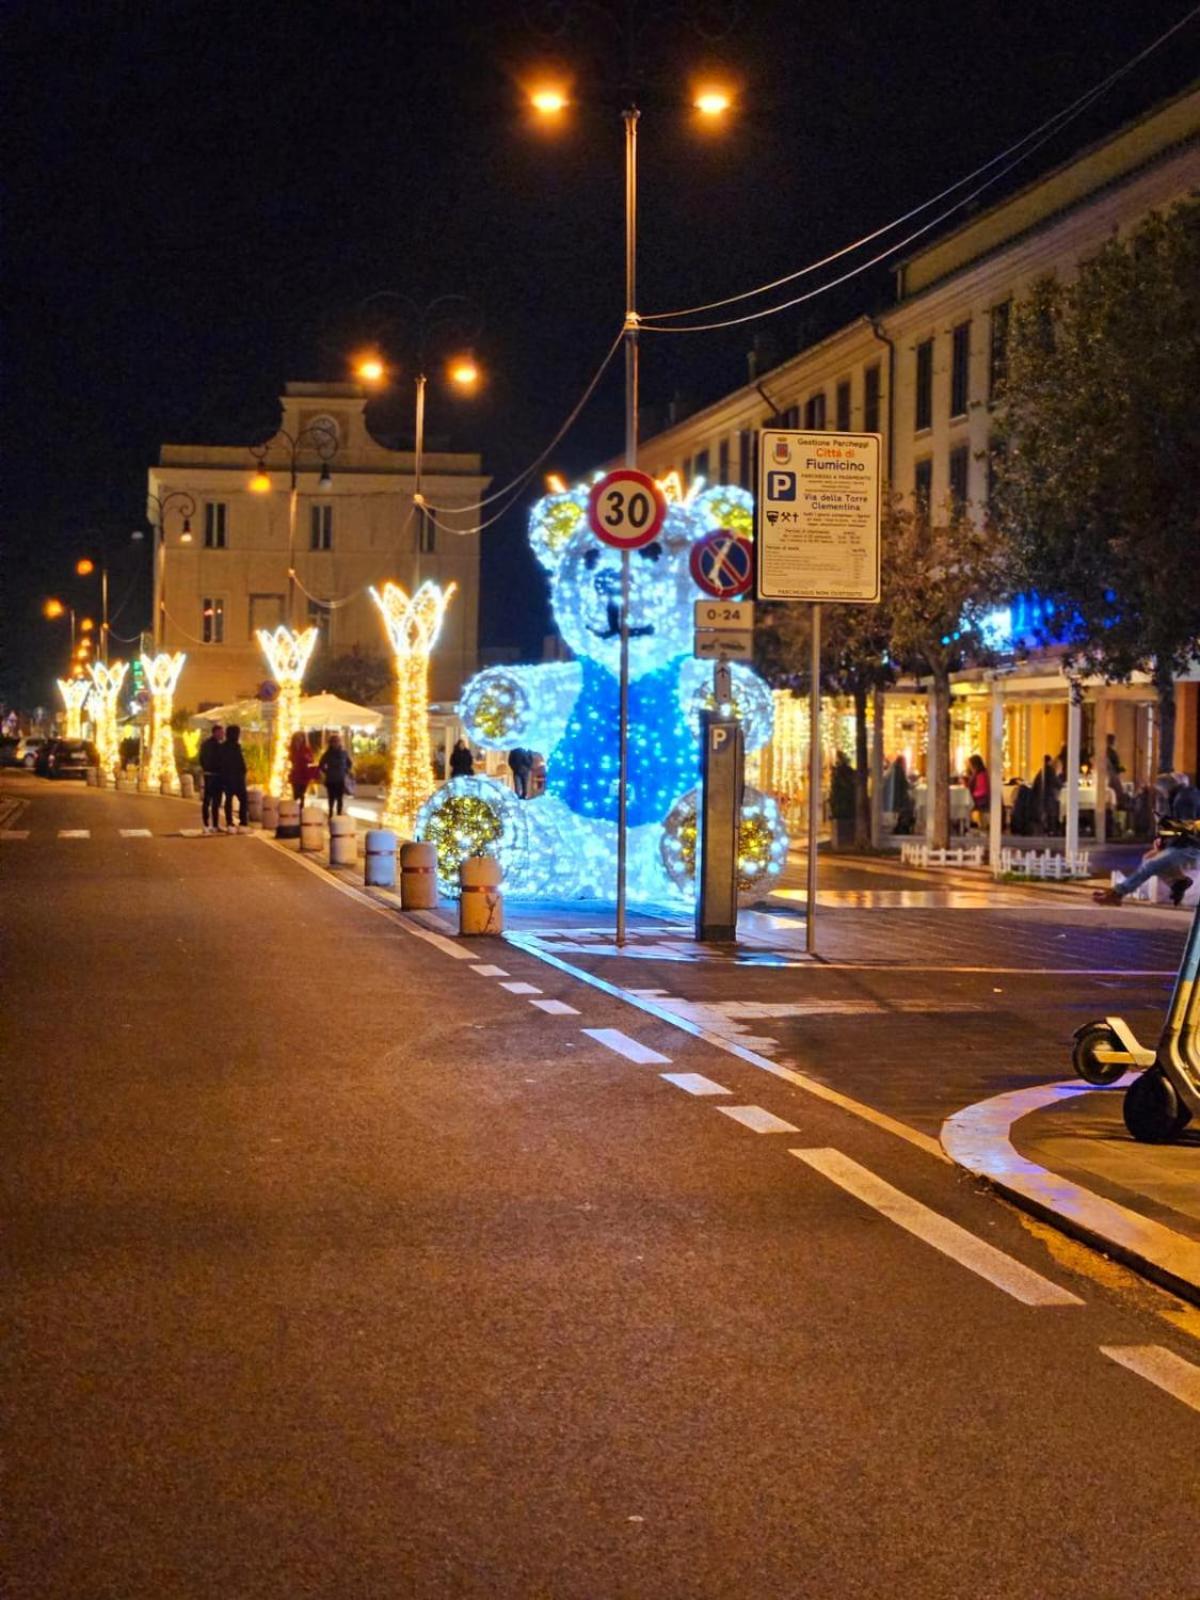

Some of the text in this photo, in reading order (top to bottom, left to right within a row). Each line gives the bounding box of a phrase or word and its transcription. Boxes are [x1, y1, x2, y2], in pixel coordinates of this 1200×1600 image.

[797, 438, 830, 446] Gestione
[816, 447, 855, 458] Città di
[806, 458, 865, 471] Fiumicino
[773, 474, 791, 498] P
[820, 494, 842, 502] della
[845, 494, 868, 503] Torre
[605, 492, 649, 528] 30
[811, 502, 860, 511] Clementina
[706, 609, 740, 620] 0-24
[713, 729, 727, 750] P
